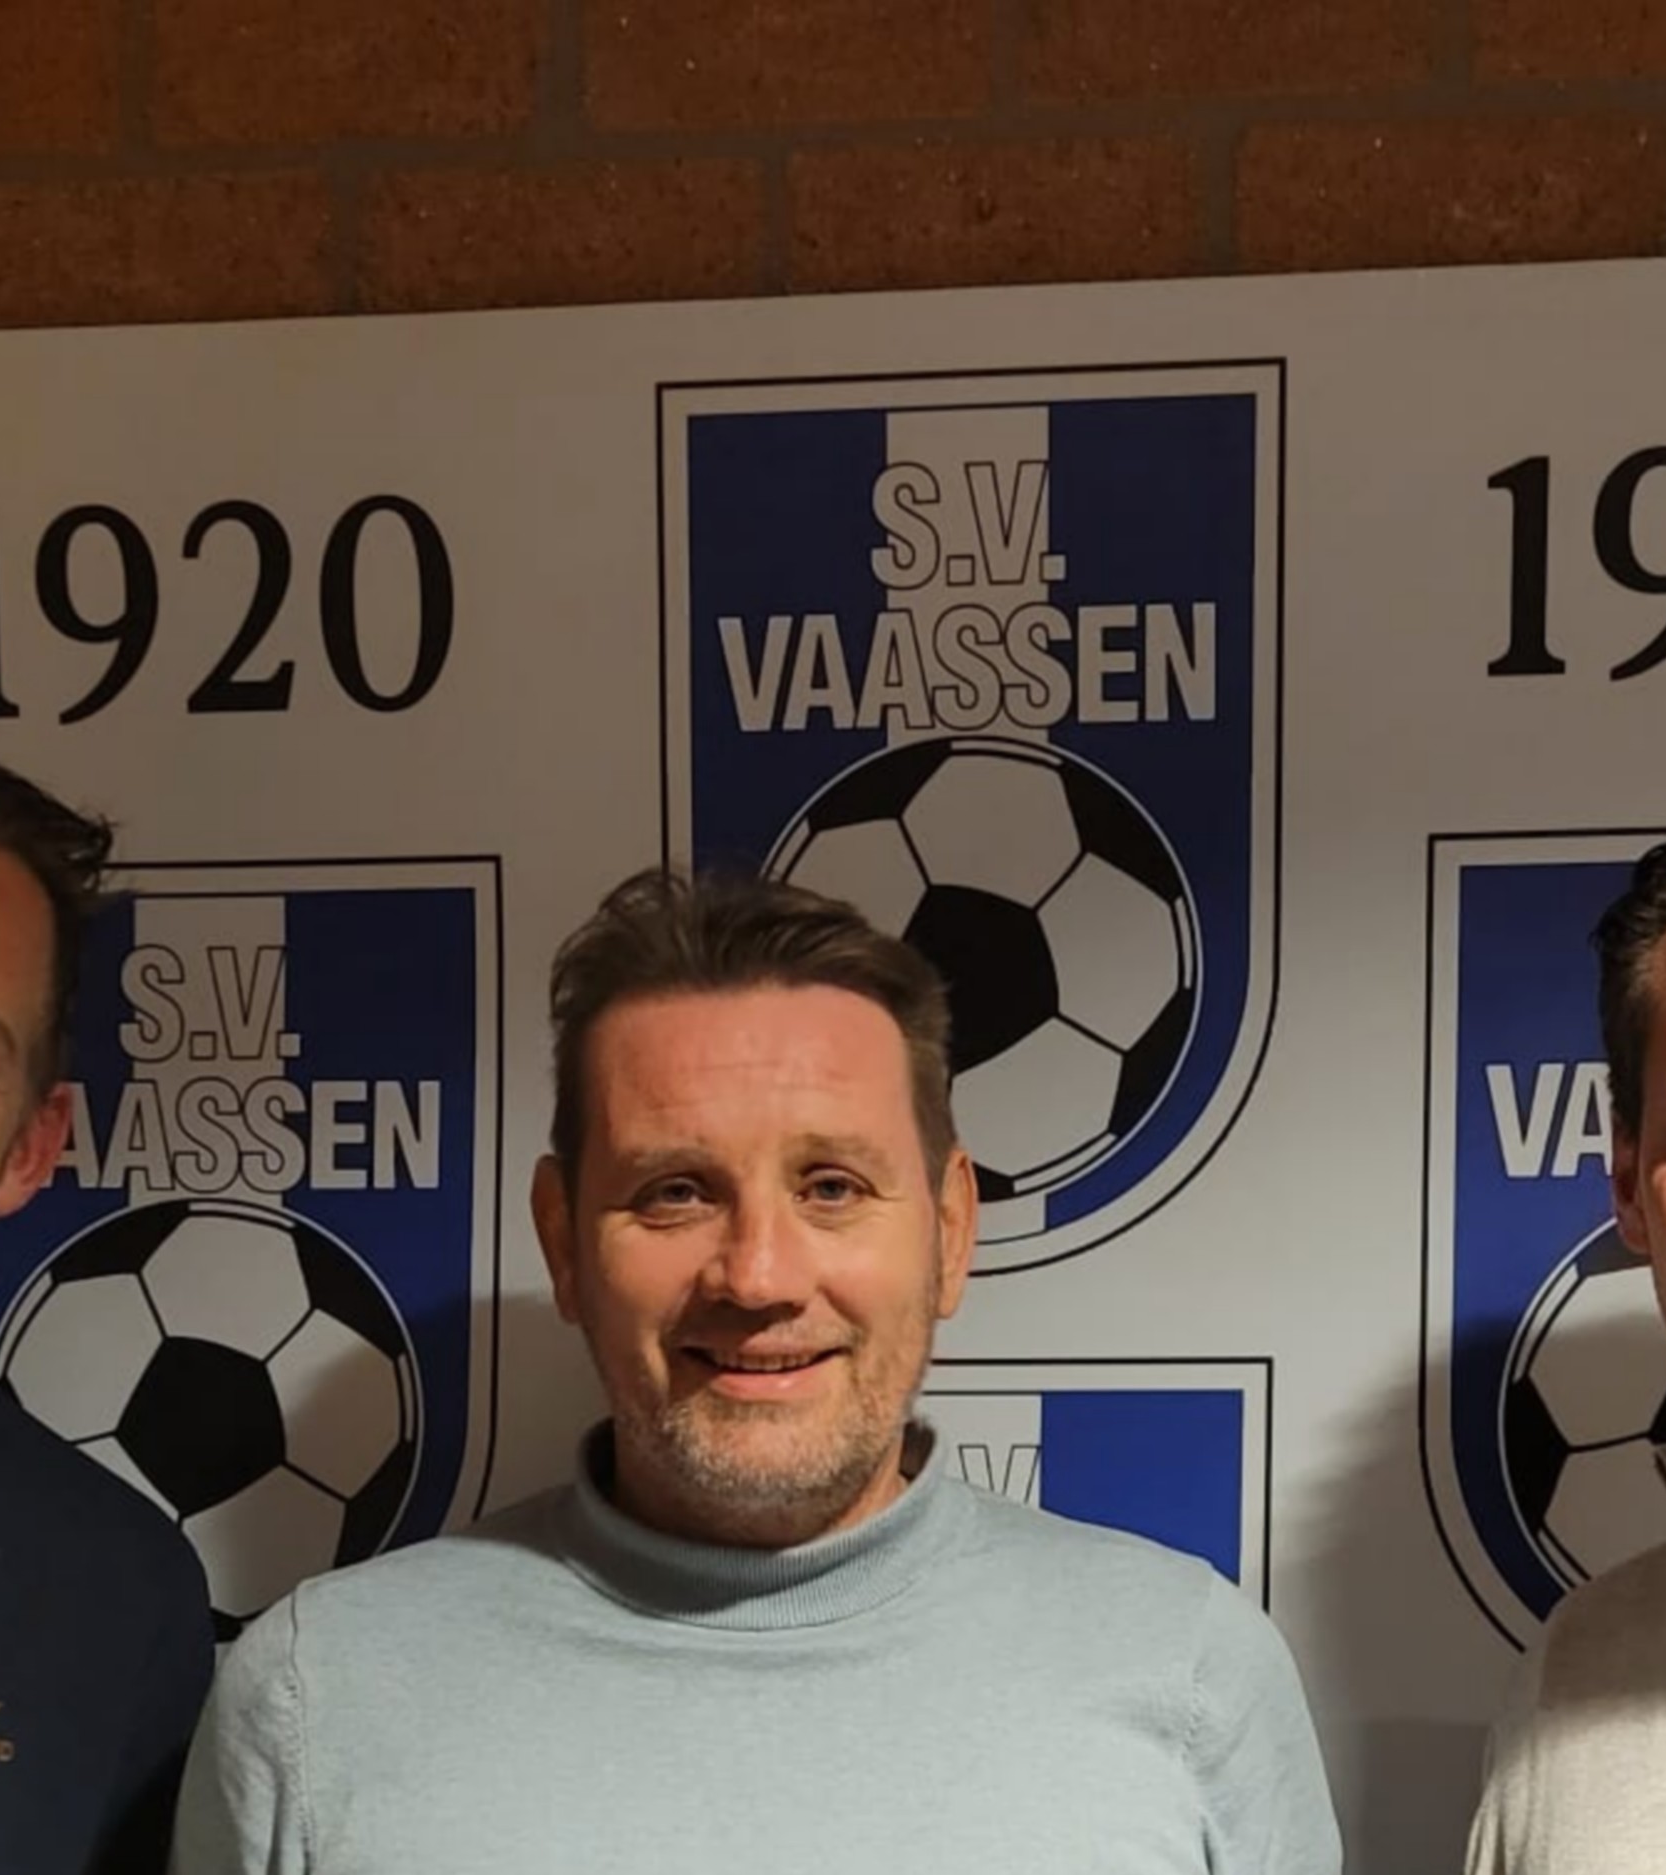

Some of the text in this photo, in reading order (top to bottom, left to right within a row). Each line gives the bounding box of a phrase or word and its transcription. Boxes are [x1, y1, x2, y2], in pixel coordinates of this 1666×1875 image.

[870, 459, 1067, 590] S.V.
[717, 602, 1217, 732] VAASSEN
[118, 943, 301, 1064] S.V.
[39, 1075, 441, 1194] AASSEN
